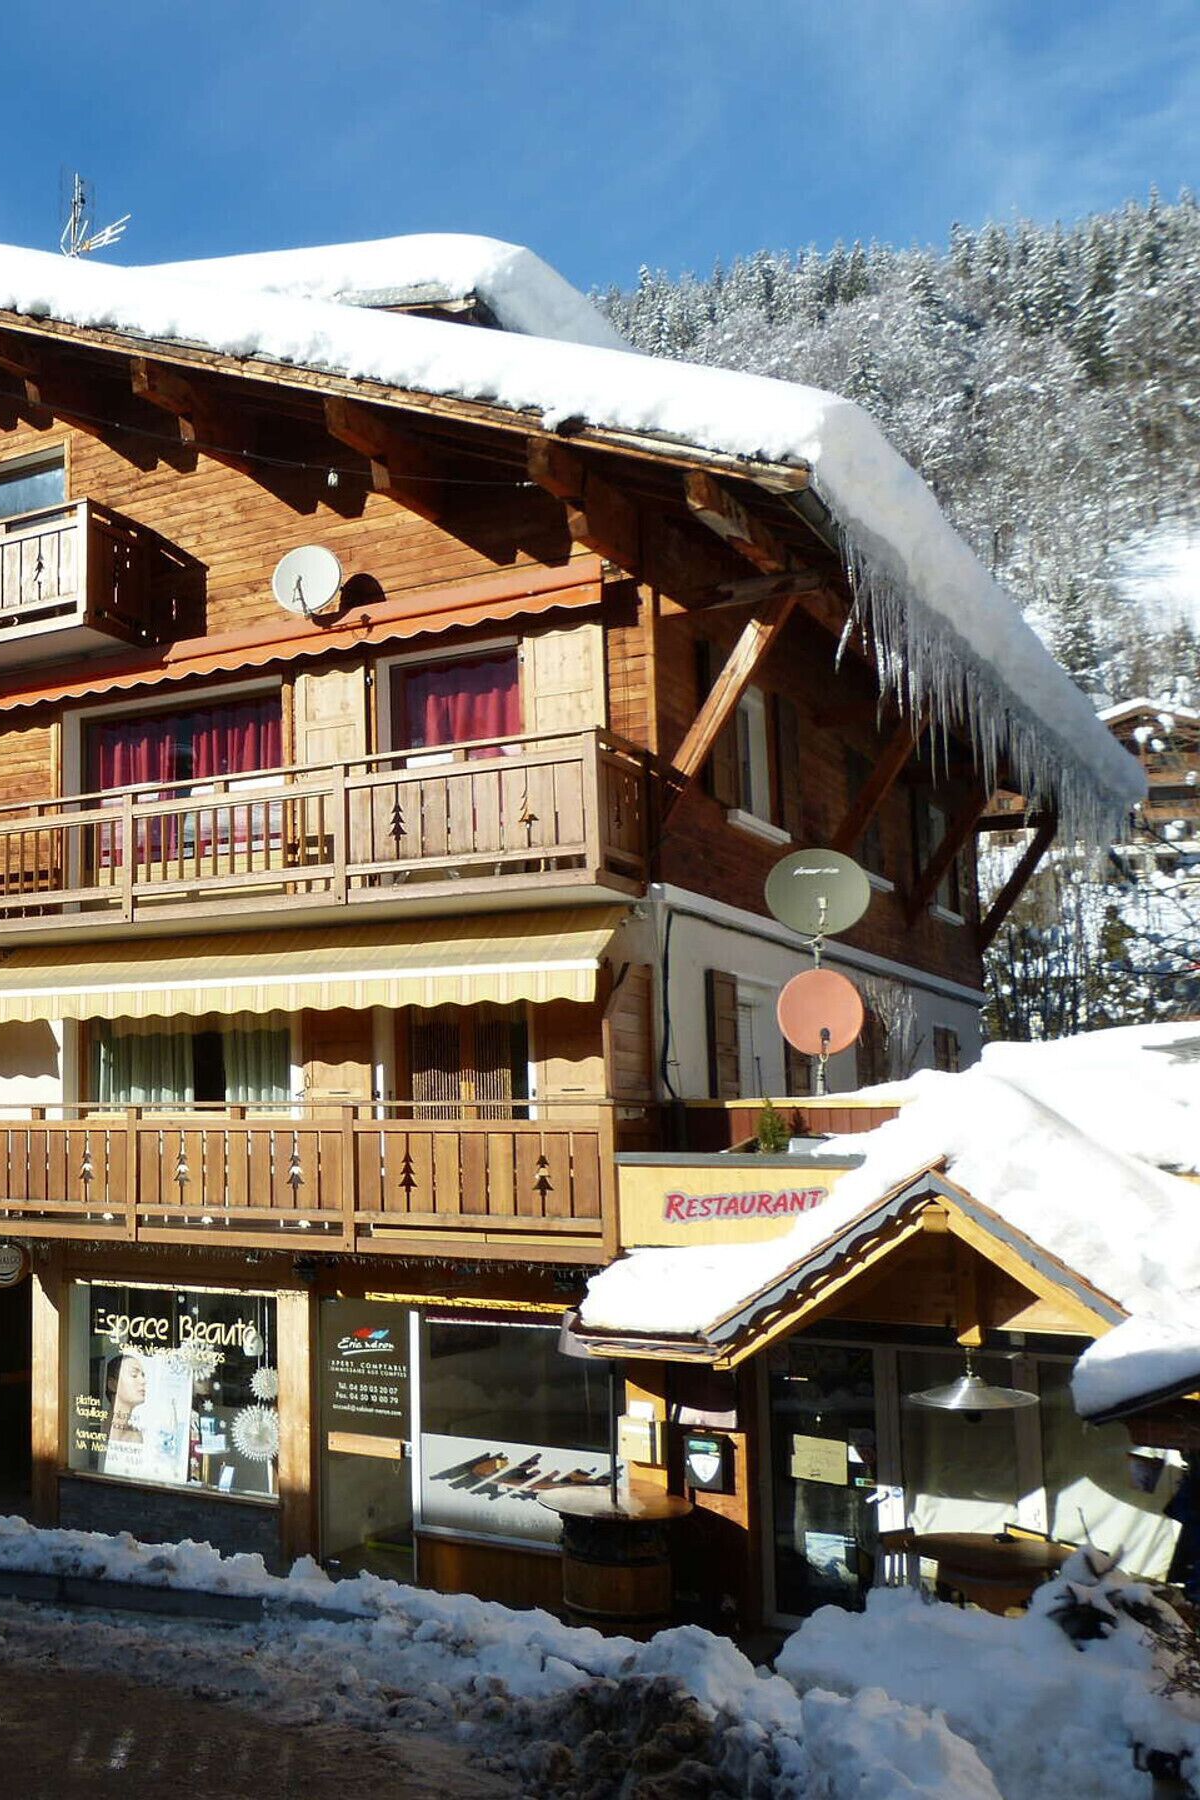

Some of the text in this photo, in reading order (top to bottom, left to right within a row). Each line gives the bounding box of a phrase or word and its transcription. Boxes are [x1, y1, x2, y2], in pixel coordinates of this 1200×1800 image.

[665, 1189, 824, 1221] RESTAURANT
[94, 1308, 258, 1347] Espace Beauté
[360, 1362, 407, 1372] COMPTABLE
[348, 1383, 358, 1392] 04
[349, 1392, 359, 1400] 04
